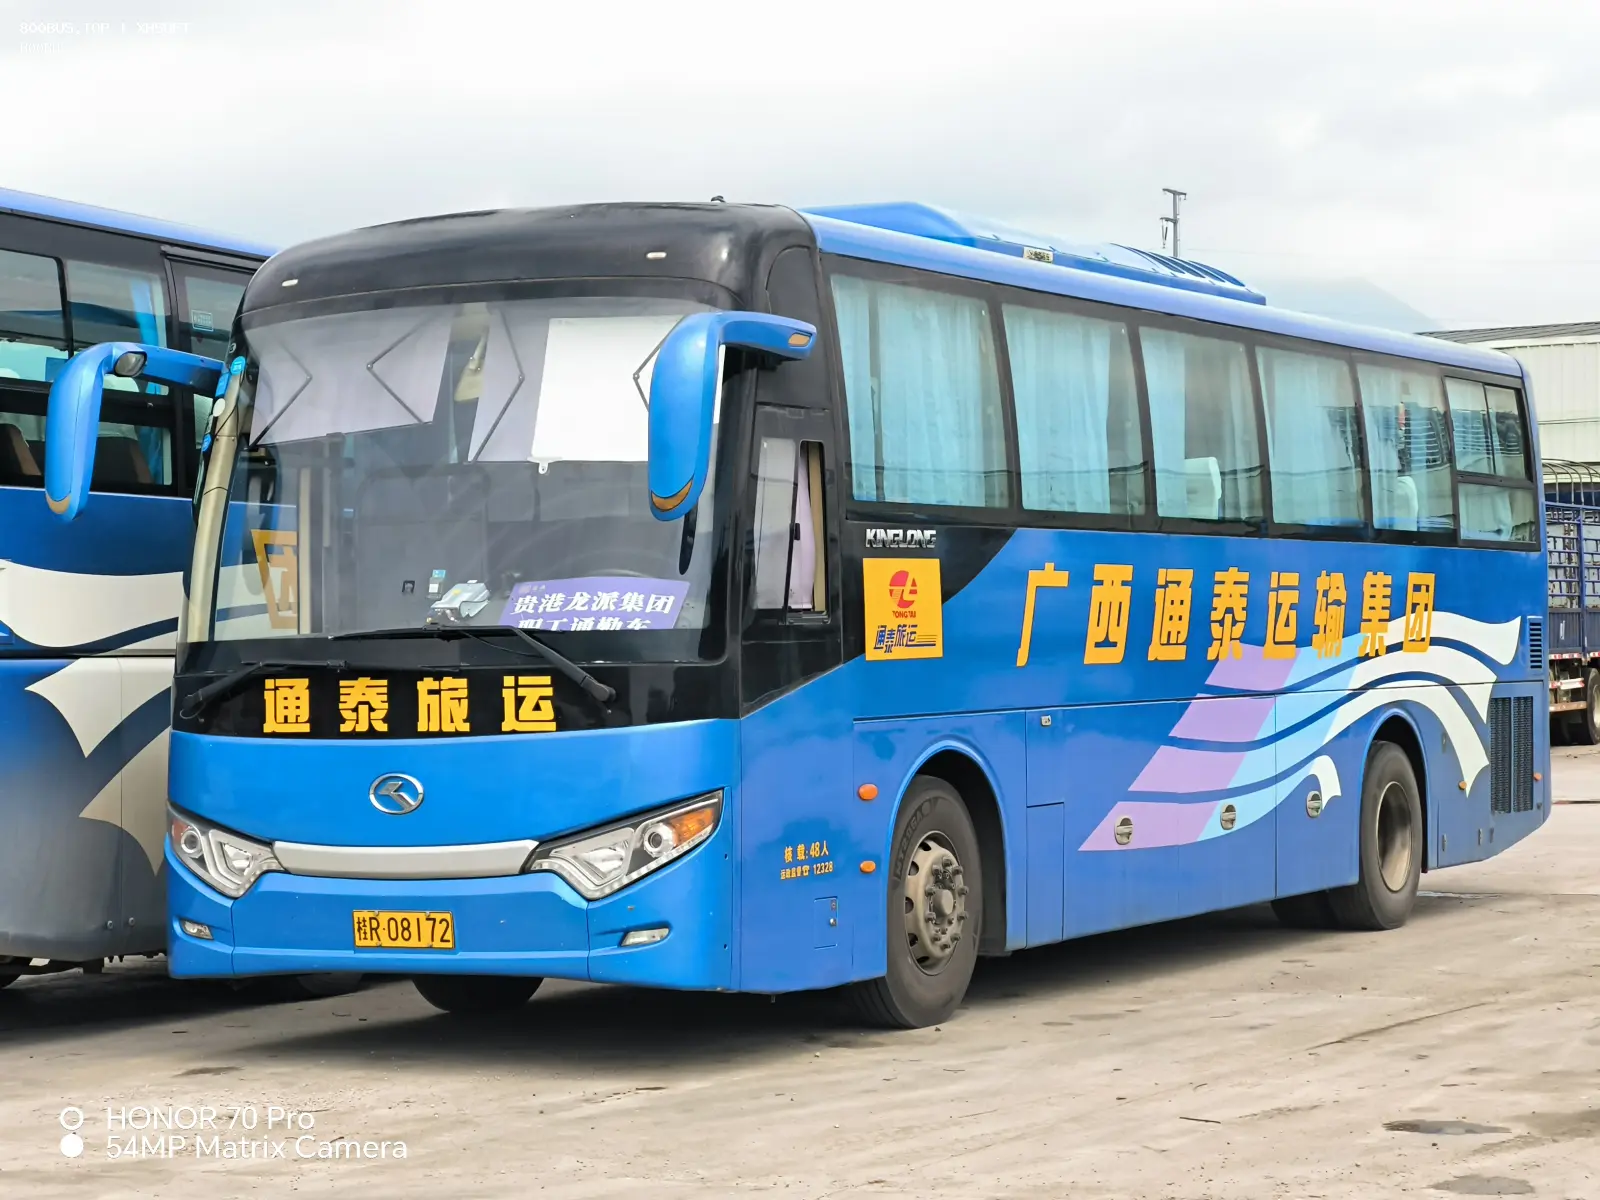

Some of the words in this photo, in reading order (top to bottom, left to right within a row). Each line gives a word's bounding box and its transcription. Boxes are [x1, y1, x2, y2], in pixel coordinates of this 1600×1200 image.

[510, 591, 676, 614] 贵港龙派集团
[1016, 562, 1436, 667] 广西通泰运输集团
[263, 676, 557, 733] 通泰旅运
[813, 861, 834, 875] 12328
